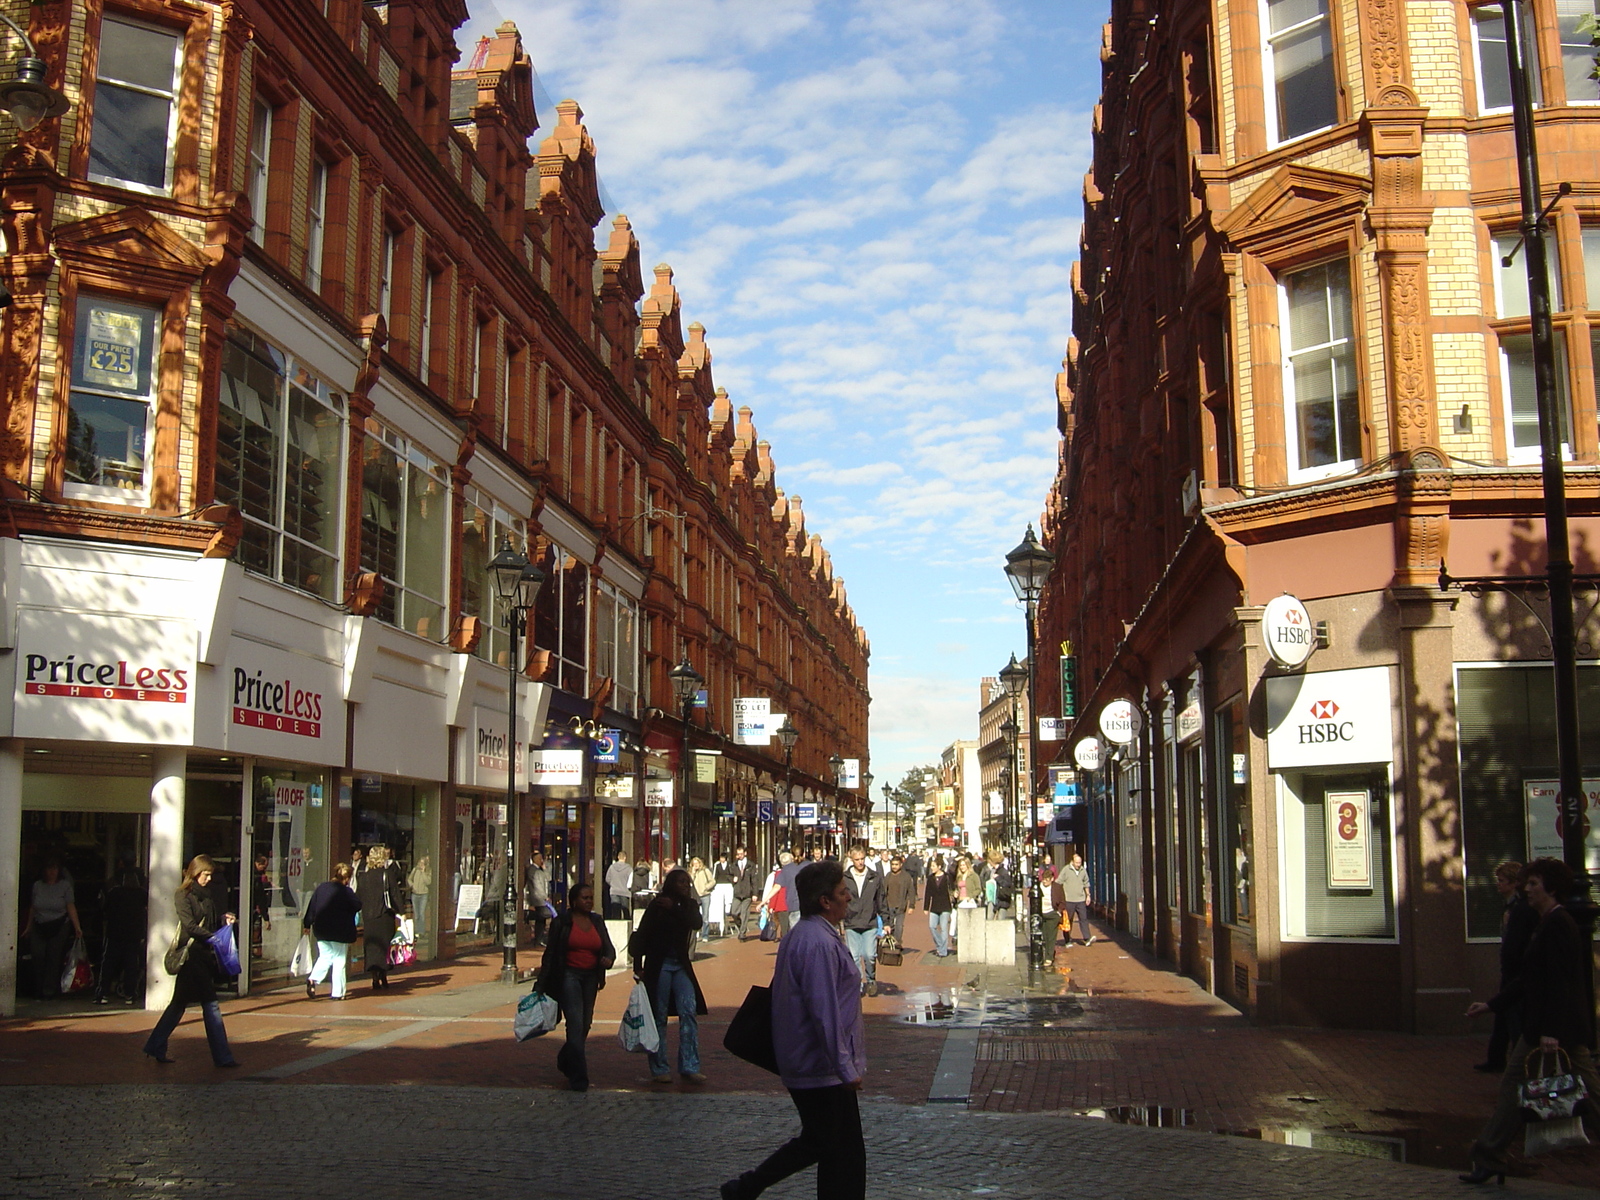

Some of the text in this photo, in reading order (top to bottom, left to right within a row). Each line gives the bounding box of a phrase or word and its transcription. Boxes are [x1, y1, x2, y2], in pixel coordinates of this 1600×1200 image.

[93, 342, 131, 354] OUR PRICE
[91, 350, 131, 373] £25
[1277, 627, 1310, 646] HSBC
[25, 654, 188, 691] PriceLess
[37, 684, 177, 703] SHOES
[234, 667, 322, 722] PriceLess
[1064, 660, 1075, 715] ROLEX
[239, 710, 317, 736] SHOES
[1106, 720, 1139, 731] HSBC
[1298, 722, 1354, 744] HSBC
[534, 761, 579, 770] PriceLess
[1078, 753, 1104, 761] HSBC
[276, 787, 305, 807] £10 OFF
[1531, 787, 1555, 797] Earn
[289, 858, 302, 877] £15
